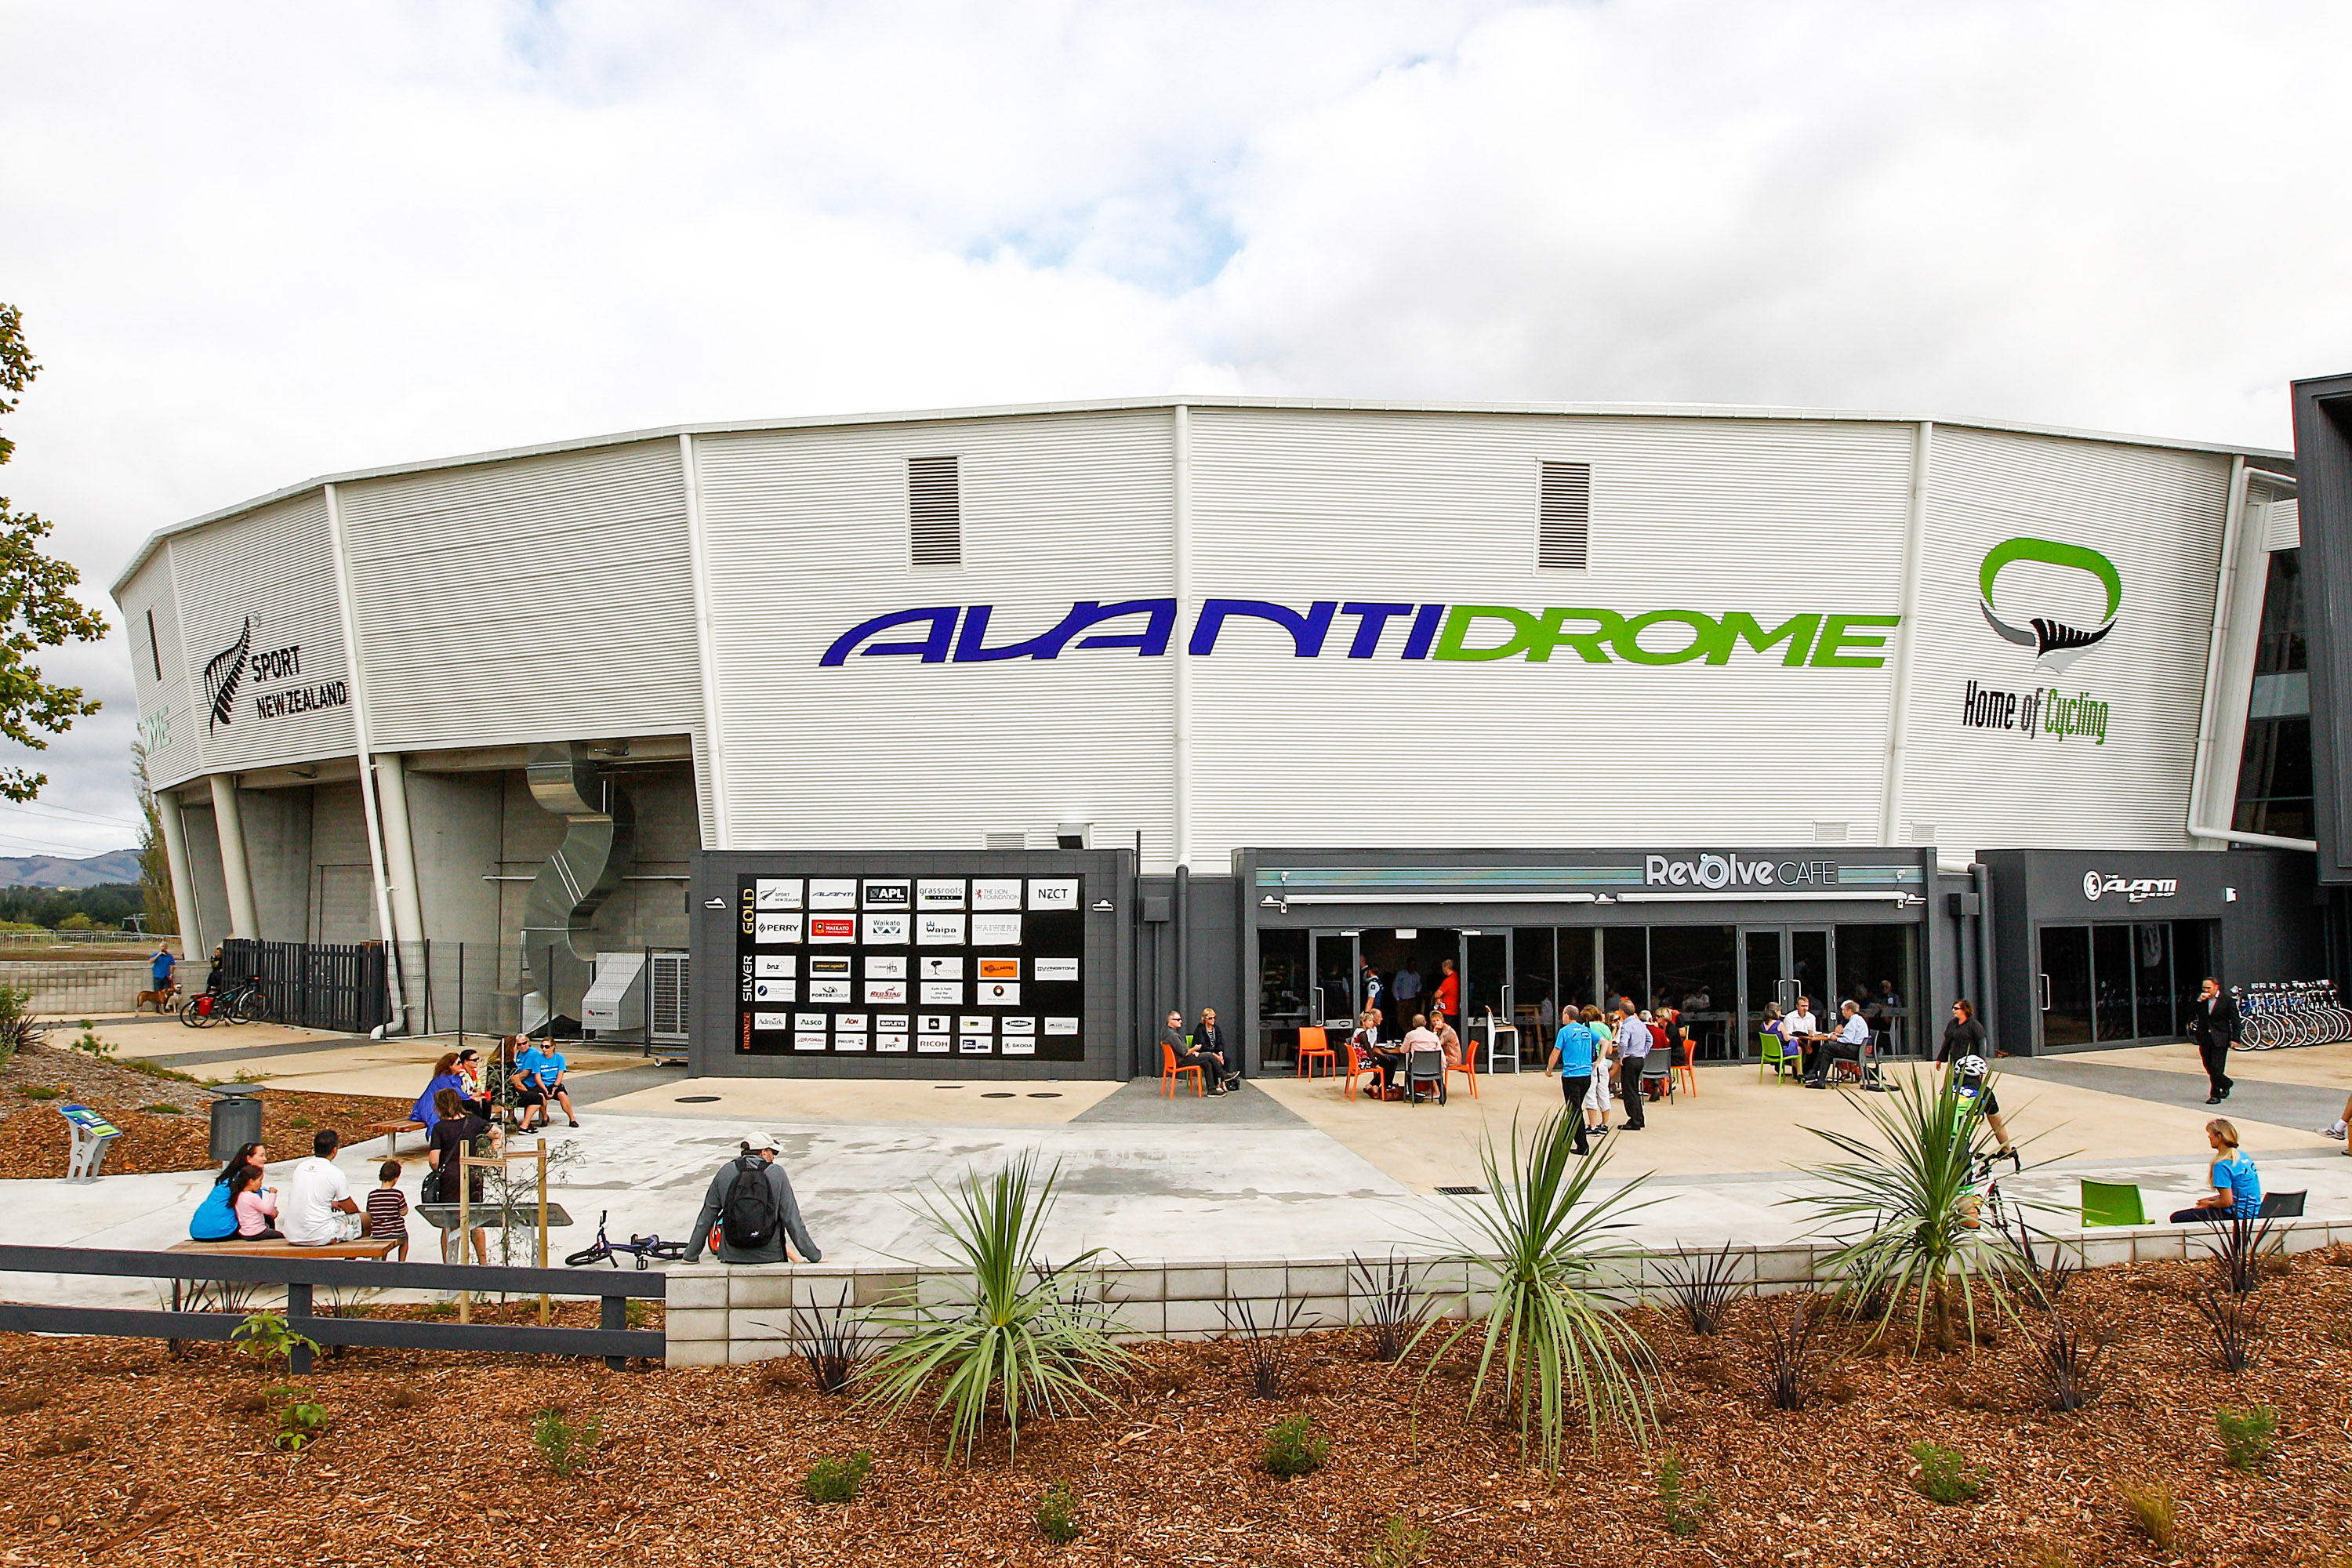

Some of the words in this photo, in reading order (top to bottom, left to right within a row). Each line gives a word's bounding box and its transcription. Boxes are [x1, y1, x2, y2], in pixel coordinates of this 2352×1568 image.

[251, 644, 300, 683] SPORT
[256, 693, 285, 720] NEW
[285, 681, 347, 715] ZEALAND
[1962, 680, 2016, 729] Home
[2020, 688, 2043, 739] of
[2045, 688, 2109, 745] Cycling
[1646, 853, 1775, 889] Revolve
[1777, 861, 1836, 886] CAFE
[742, 888, 754, 934] GOLD
[878, 888, 905, 898] APL
[919, 887, 963, 896] grassroots
[1038, 889, 1068, 899] NZCT
[742, 955, 753, 1002] SILVER
